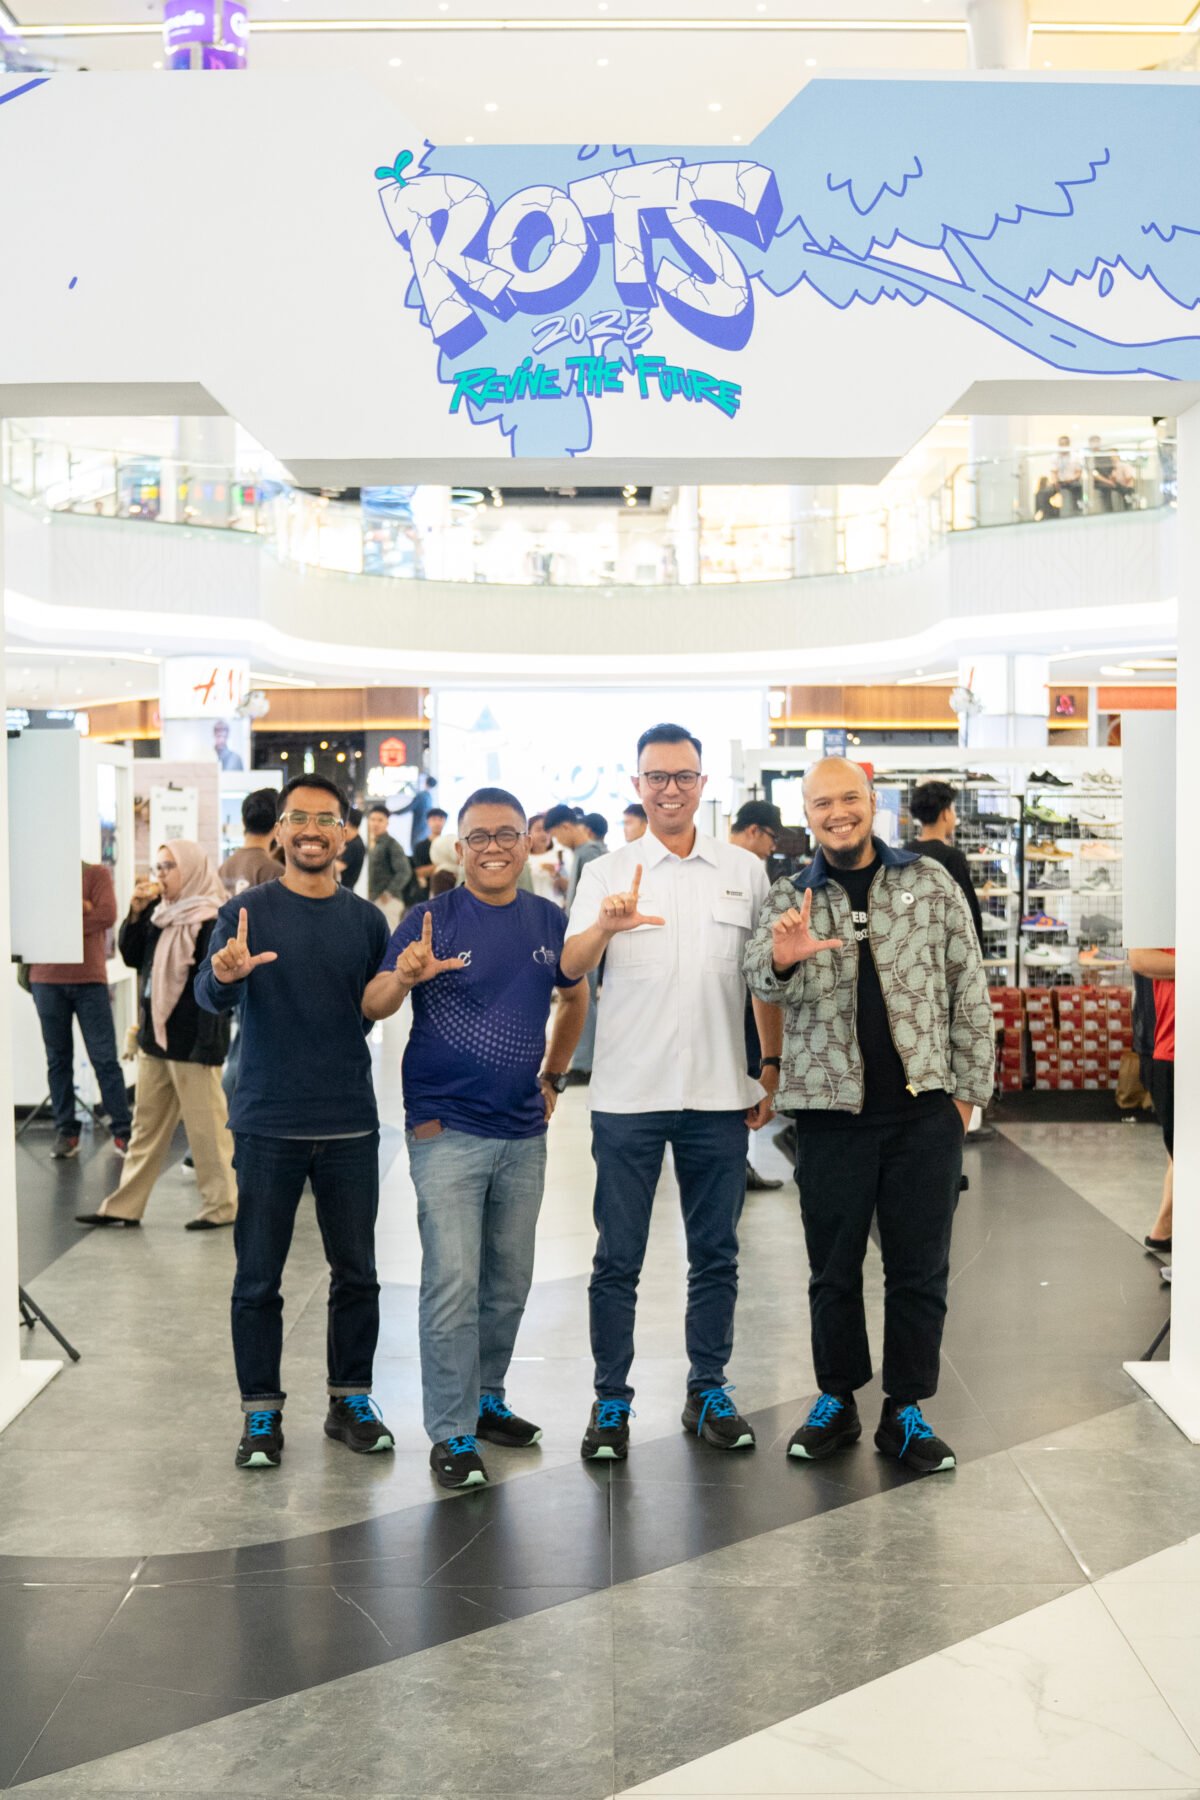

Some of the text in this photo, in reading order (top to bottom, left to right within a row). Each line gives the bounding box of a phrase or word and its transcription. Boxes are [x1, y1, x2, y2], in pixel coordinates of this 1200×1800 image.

[377, 157, 782, 358] ROTS
[532, 310, 653, 354] 2026
[565, 355, 624, 398] THE
[634, 354, 742, 419] FUTURE
